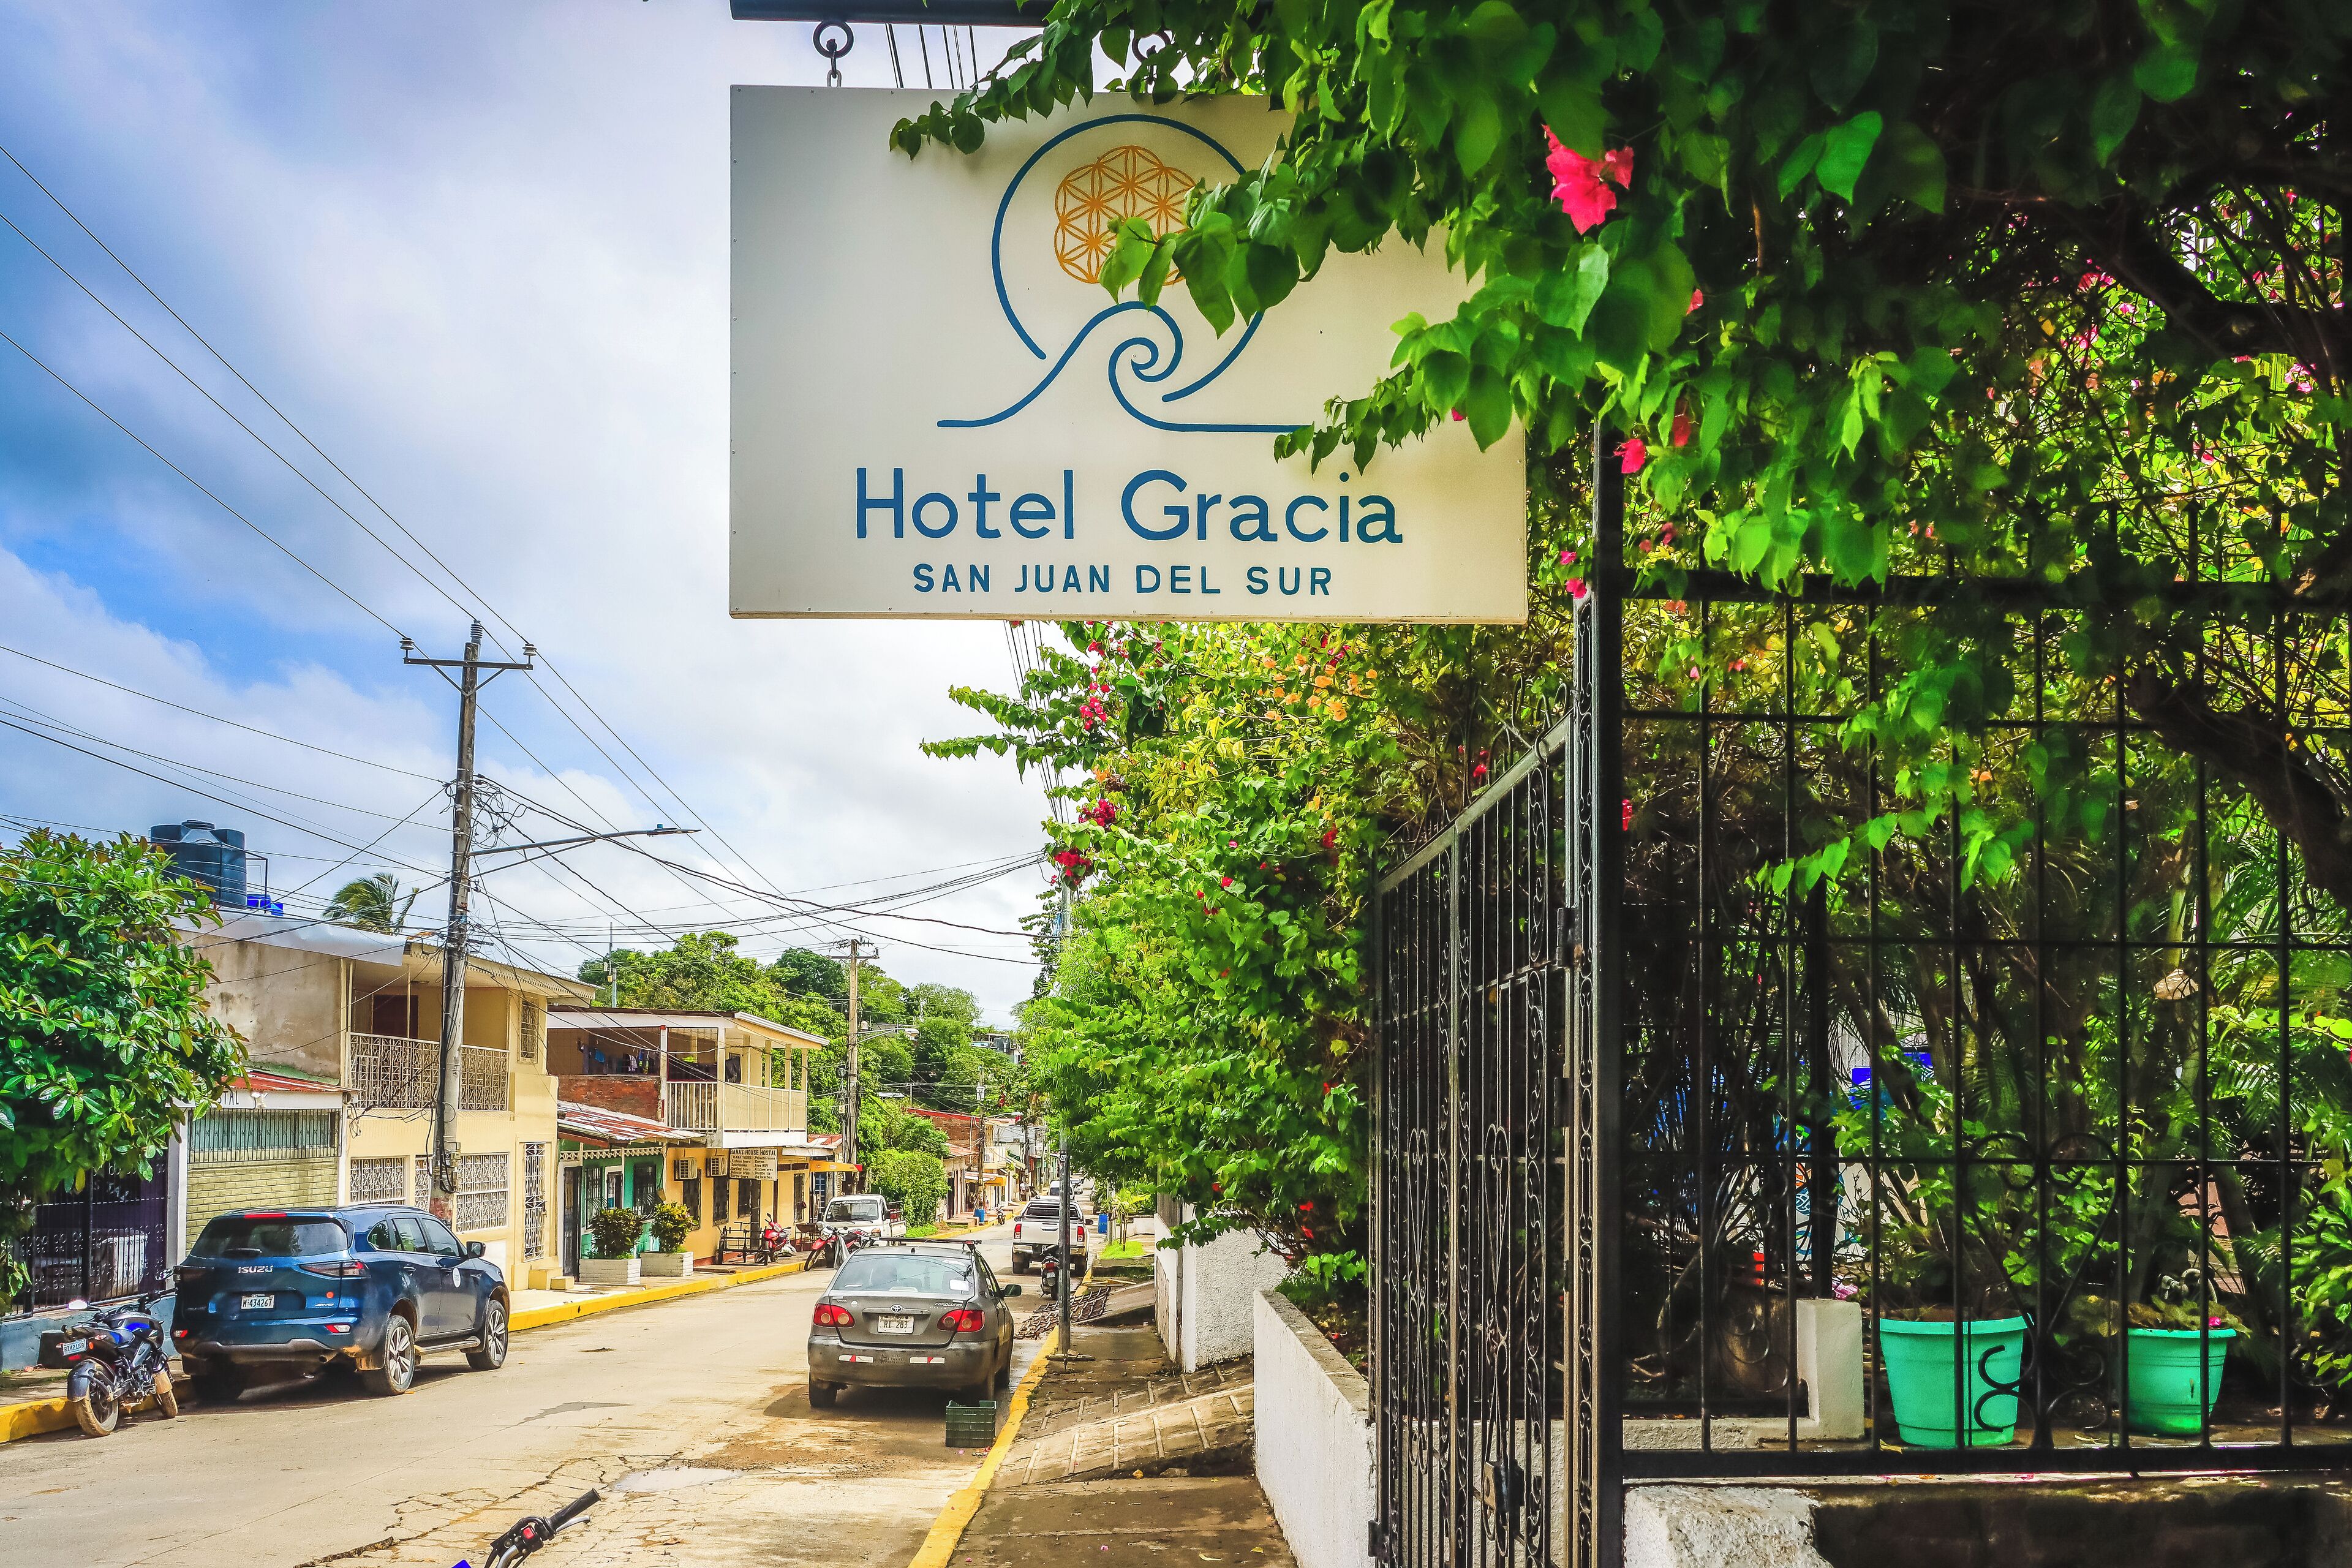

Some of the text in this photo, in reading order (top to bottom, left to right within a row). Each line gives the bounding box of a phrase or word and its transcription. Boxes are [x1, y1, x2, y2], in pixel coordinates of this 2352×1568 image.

[856, 466, 1402, 543] Hotel Gracia
[913, 563, 1331, 595] SAN JUAN DEL SUR
[238, 1265, 274, 1274] ISUZU
